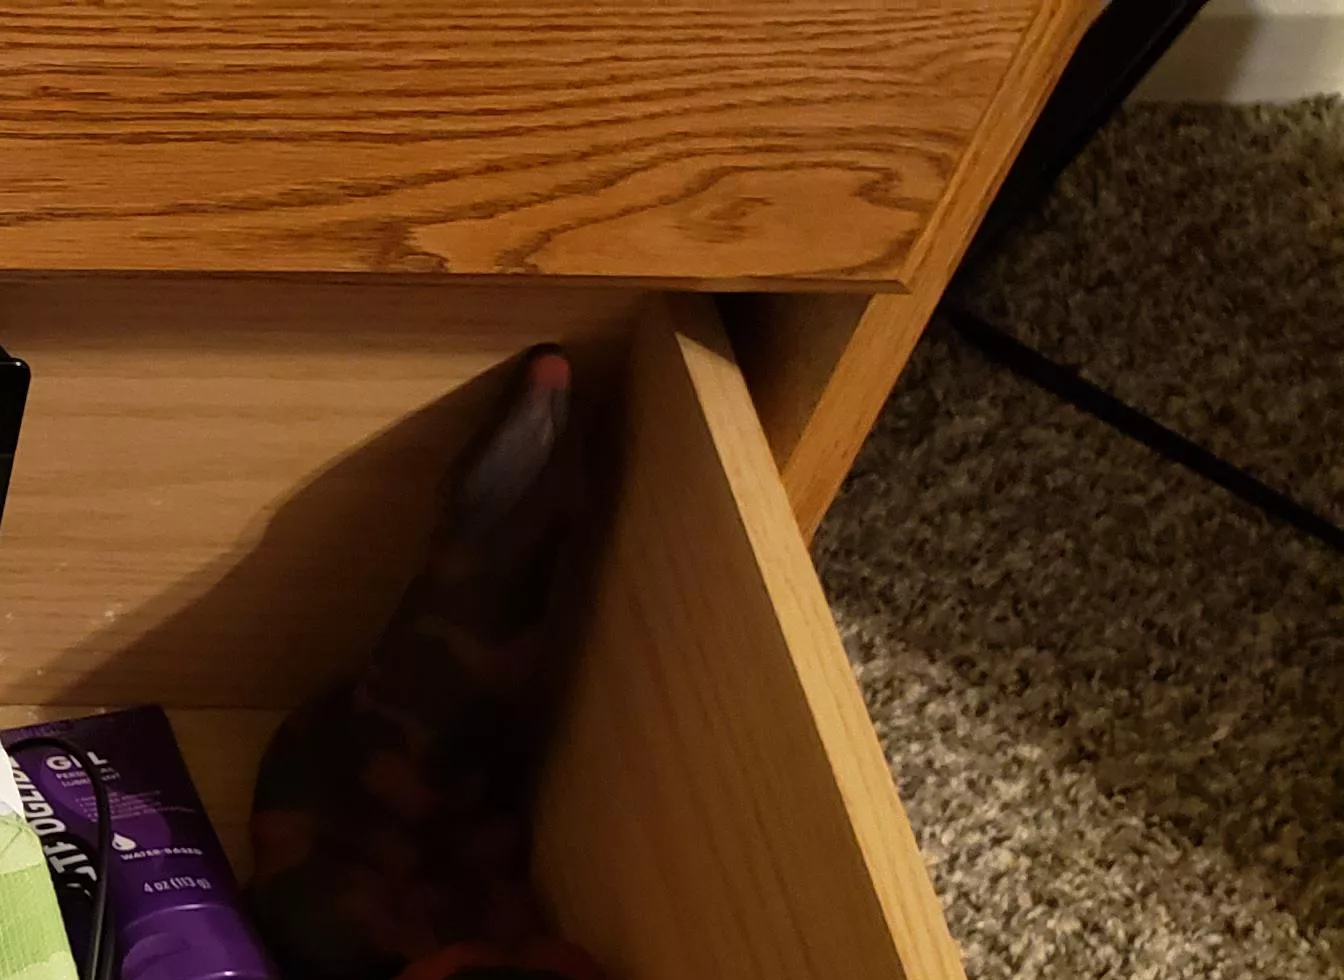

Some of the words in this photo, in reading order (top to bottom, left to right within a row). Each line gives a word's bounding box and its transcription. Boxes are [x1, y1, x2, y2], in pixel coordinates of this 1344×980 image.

[144, 880, 155, 893] 4
[153, 880, 171, 892] oz
[170, 875, 197, 890] (113
